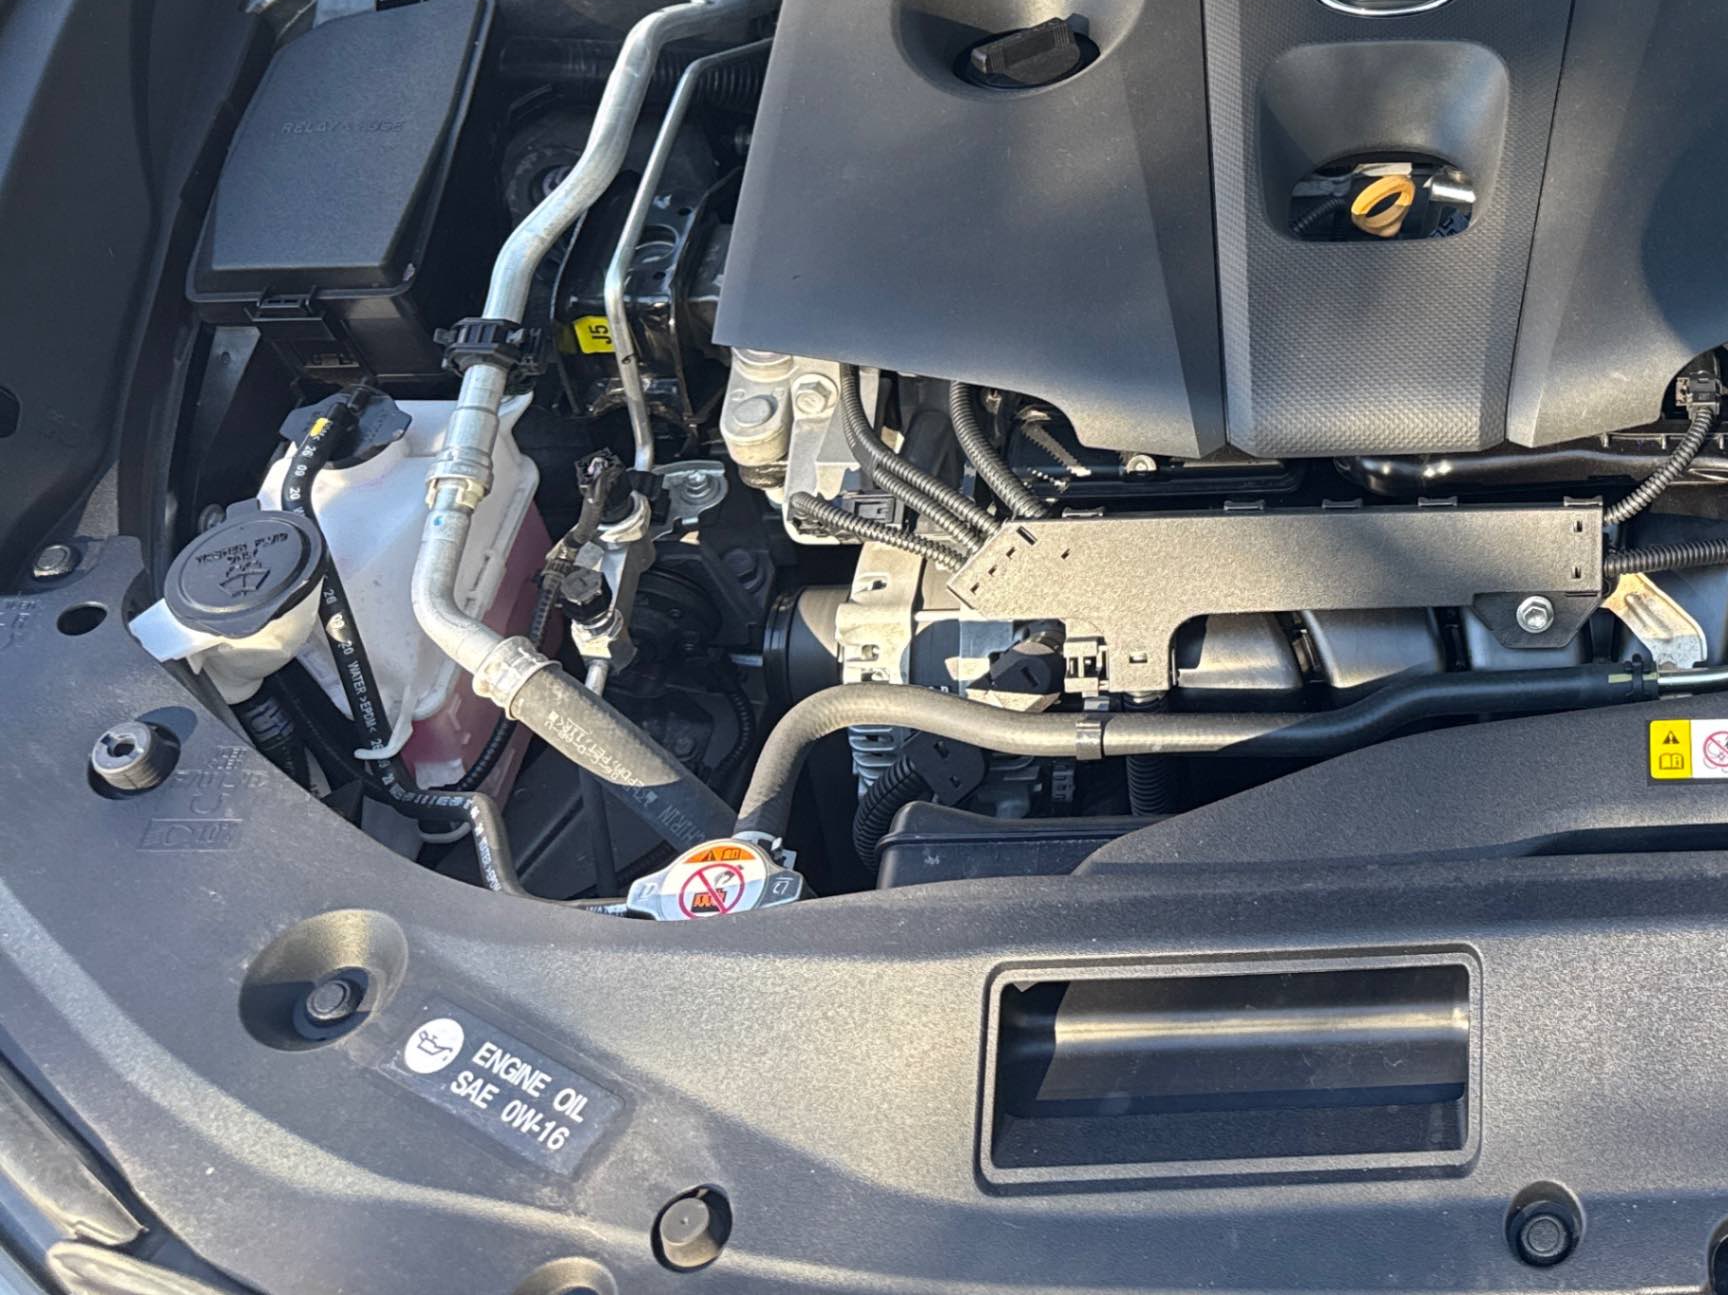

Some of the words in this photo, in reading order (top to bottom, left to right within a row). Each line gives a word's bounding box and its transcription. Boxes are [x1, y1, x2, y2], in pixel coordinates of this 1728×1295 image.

[588, 324, 612, 345] J5
[289, 487, 301, 500] 20
[347, 660, 367, 695] WATER
[471, 1040, 553, 1098] ENGINE
[552, 1087, 590, 1124] OIL
[449, 1070, 500, 1110] SAE
[500, 1099, 571, 1151] 0W-16
